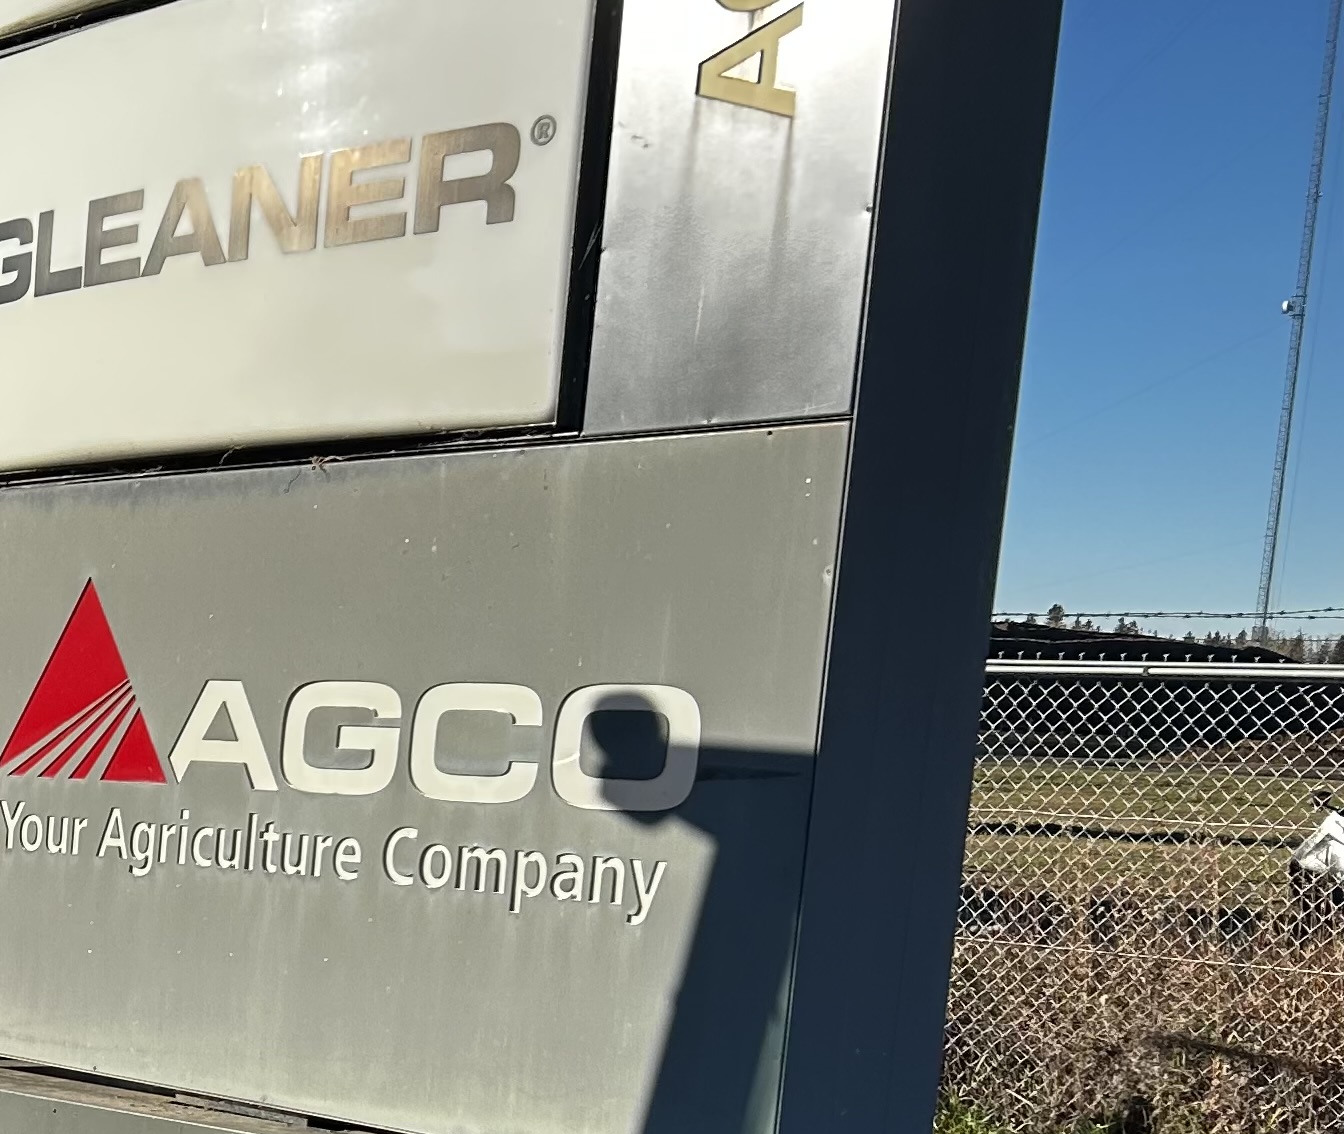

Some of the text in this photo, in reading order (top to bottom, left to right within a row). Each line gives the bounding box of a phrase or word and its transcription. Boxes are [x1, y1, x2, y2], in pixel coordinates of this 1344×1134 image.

[696, 0, 804, 118] A
[168, 679, 702, 812] AGCO
[0, 800, 668, 926] Your Agriculture Company
